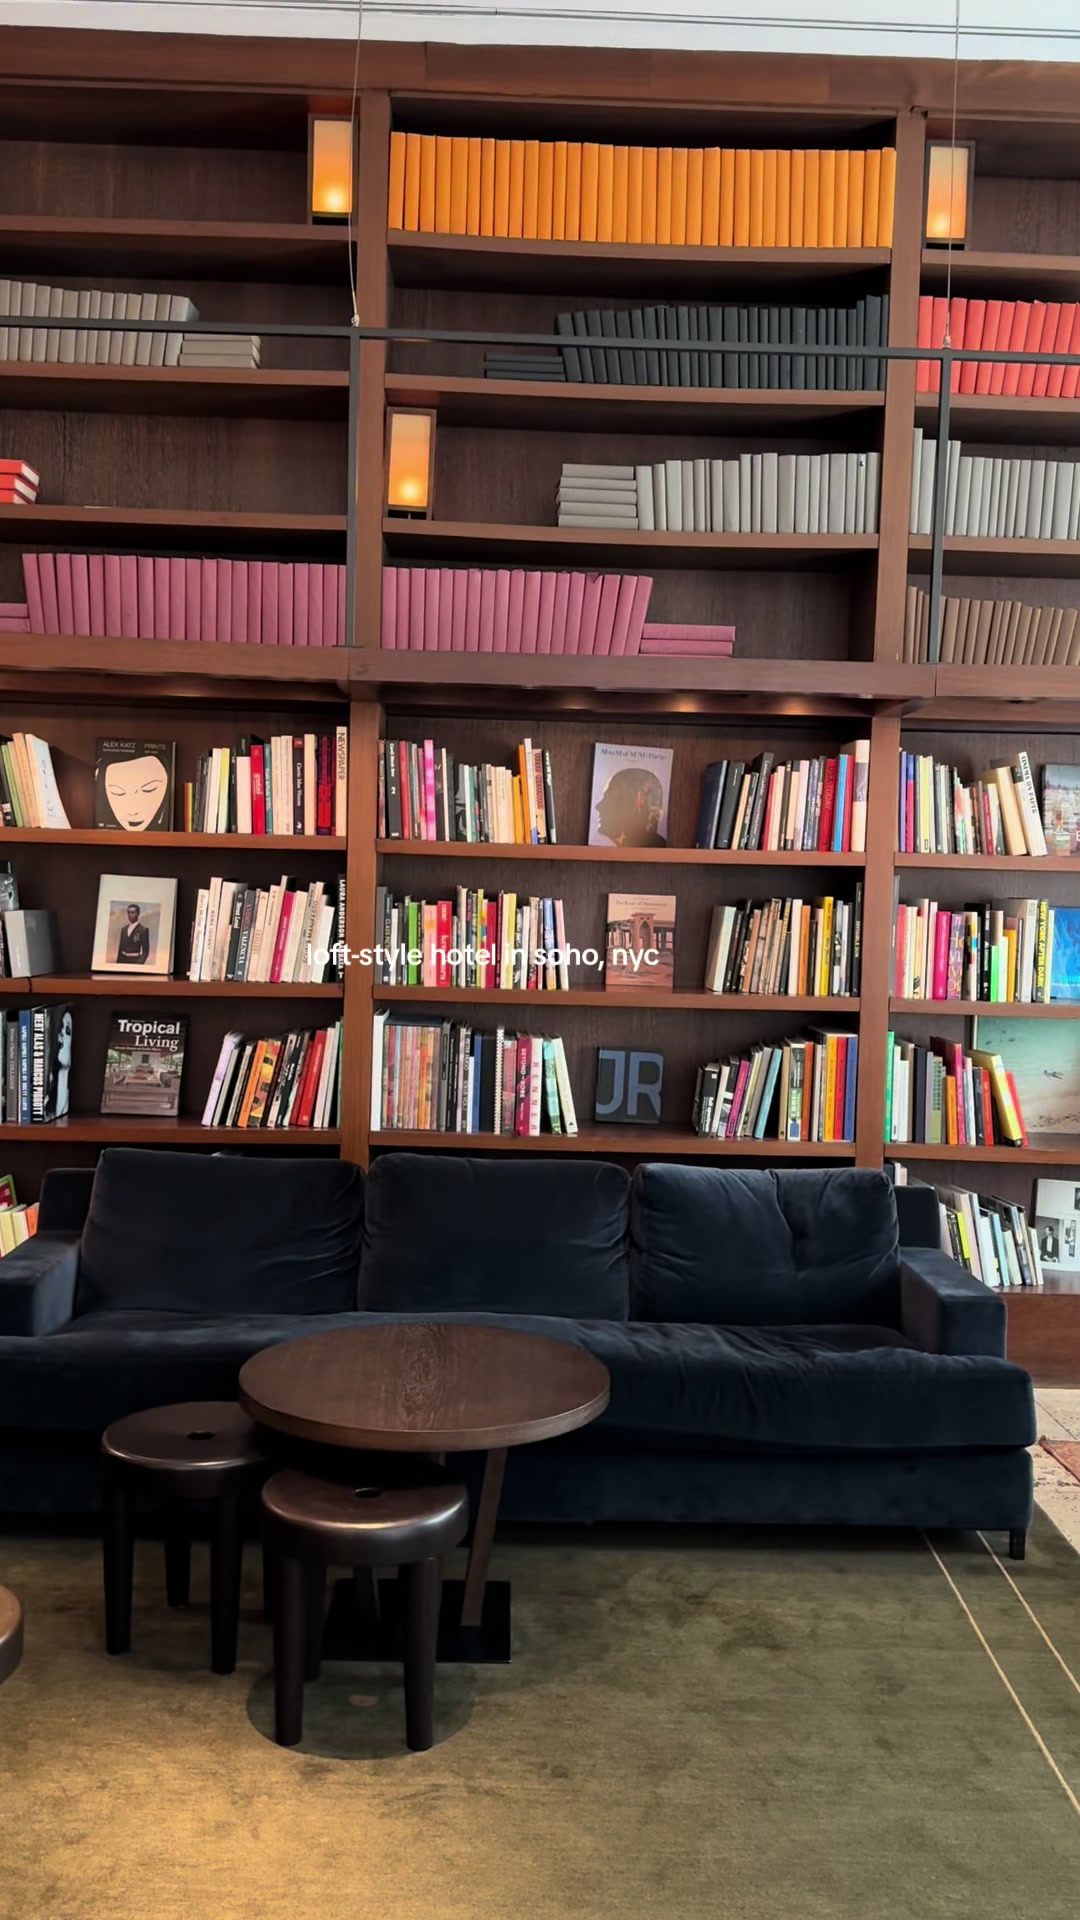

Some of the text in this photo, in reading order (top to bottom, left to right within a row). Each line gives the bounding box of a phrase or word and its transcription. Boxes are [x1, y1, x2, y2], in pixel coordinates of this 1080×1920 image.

[103, 741, 136, 750] ALEX KATZ
[144, 743, 167, 751] PRINTS
[338, 732, 346, 781] NEWSPAPER
[825, 784, 834, 810] TODAY
[338, 902, 346, 938] ANDERSON
[1039, 920, 1047, 941] YORK
[238, 930, 249, 965] VALENCIA
[337, 939, 345, 970] BABATA
[1038, 942, 1046, 966] AFTER
[1037, 966, 1045, 988] DARK
[118, 1019, 181, 1035] Tropical
[34, 1032, 44, 1050] ALAS
[135, 1035, 179, 1052] Living
[33, 1058, 43, 1086] MARCUS
[596, 1049, 665, 1117] JR
